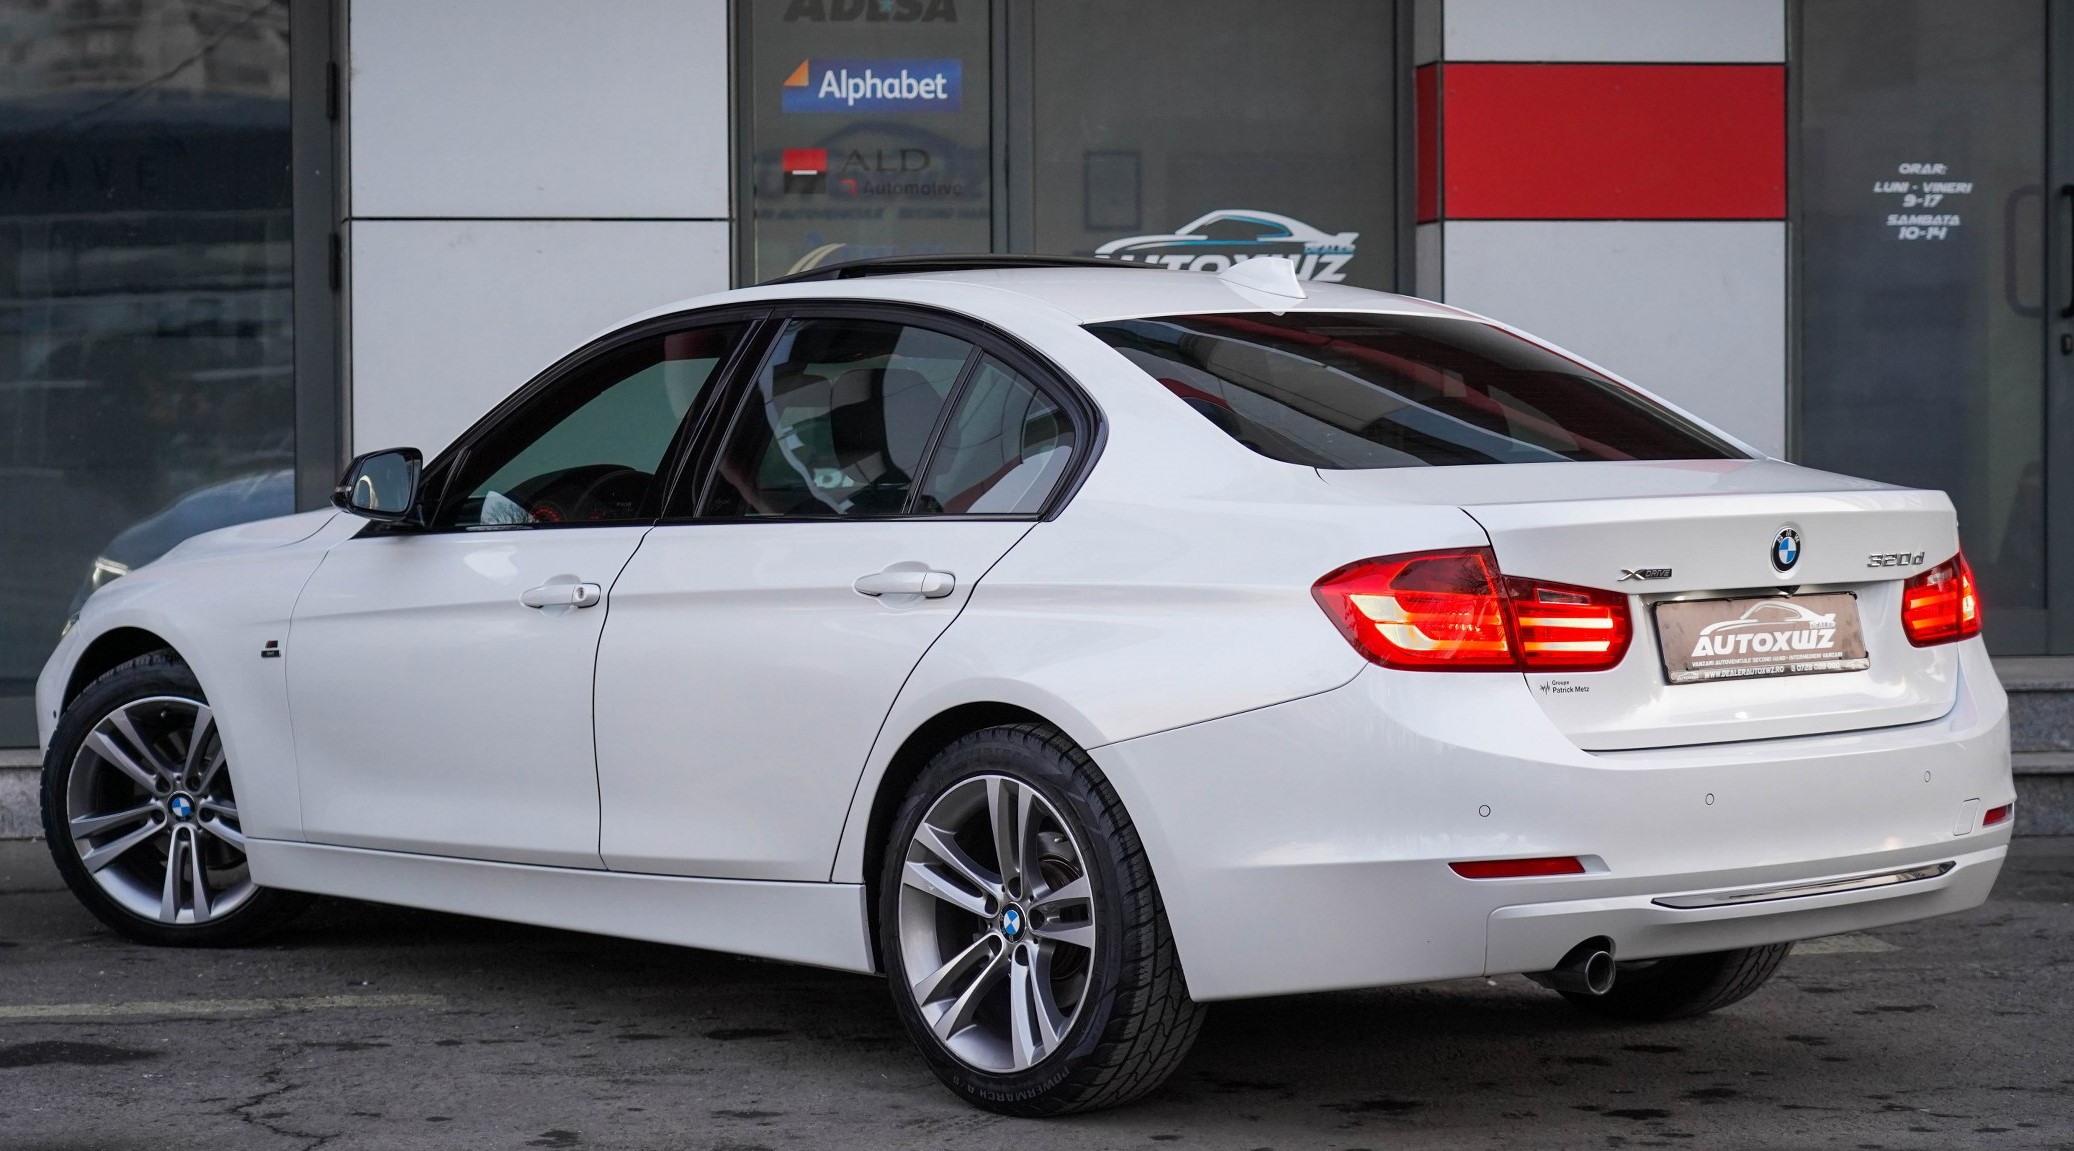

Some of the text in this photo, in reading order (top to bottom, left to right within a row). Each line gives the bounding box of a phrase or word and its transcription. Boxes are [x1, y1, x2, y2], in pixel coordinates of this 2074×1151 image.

[818, 69, 948, 106] Alphabet
[841, 148, 931, 172] ALD
[862, 181, 962, 195] Automotive
[1873, 182, 1910, 193] LUNI
[1923, 182, 1973, 194] VINERI
[1902, 194, 1944, 207] 9-17
[1886, 214, 1960, 226] SAMBATA
[1898, 226, 1948, 240] 10-14
[1866, 551, 1925, 567] 320d
[1691, 628, 1836, 657] AUTOXWZ
[1553, 686, 1574, 694] Patrick
[979, 1066, 1070, 1102] POWERMARCH
